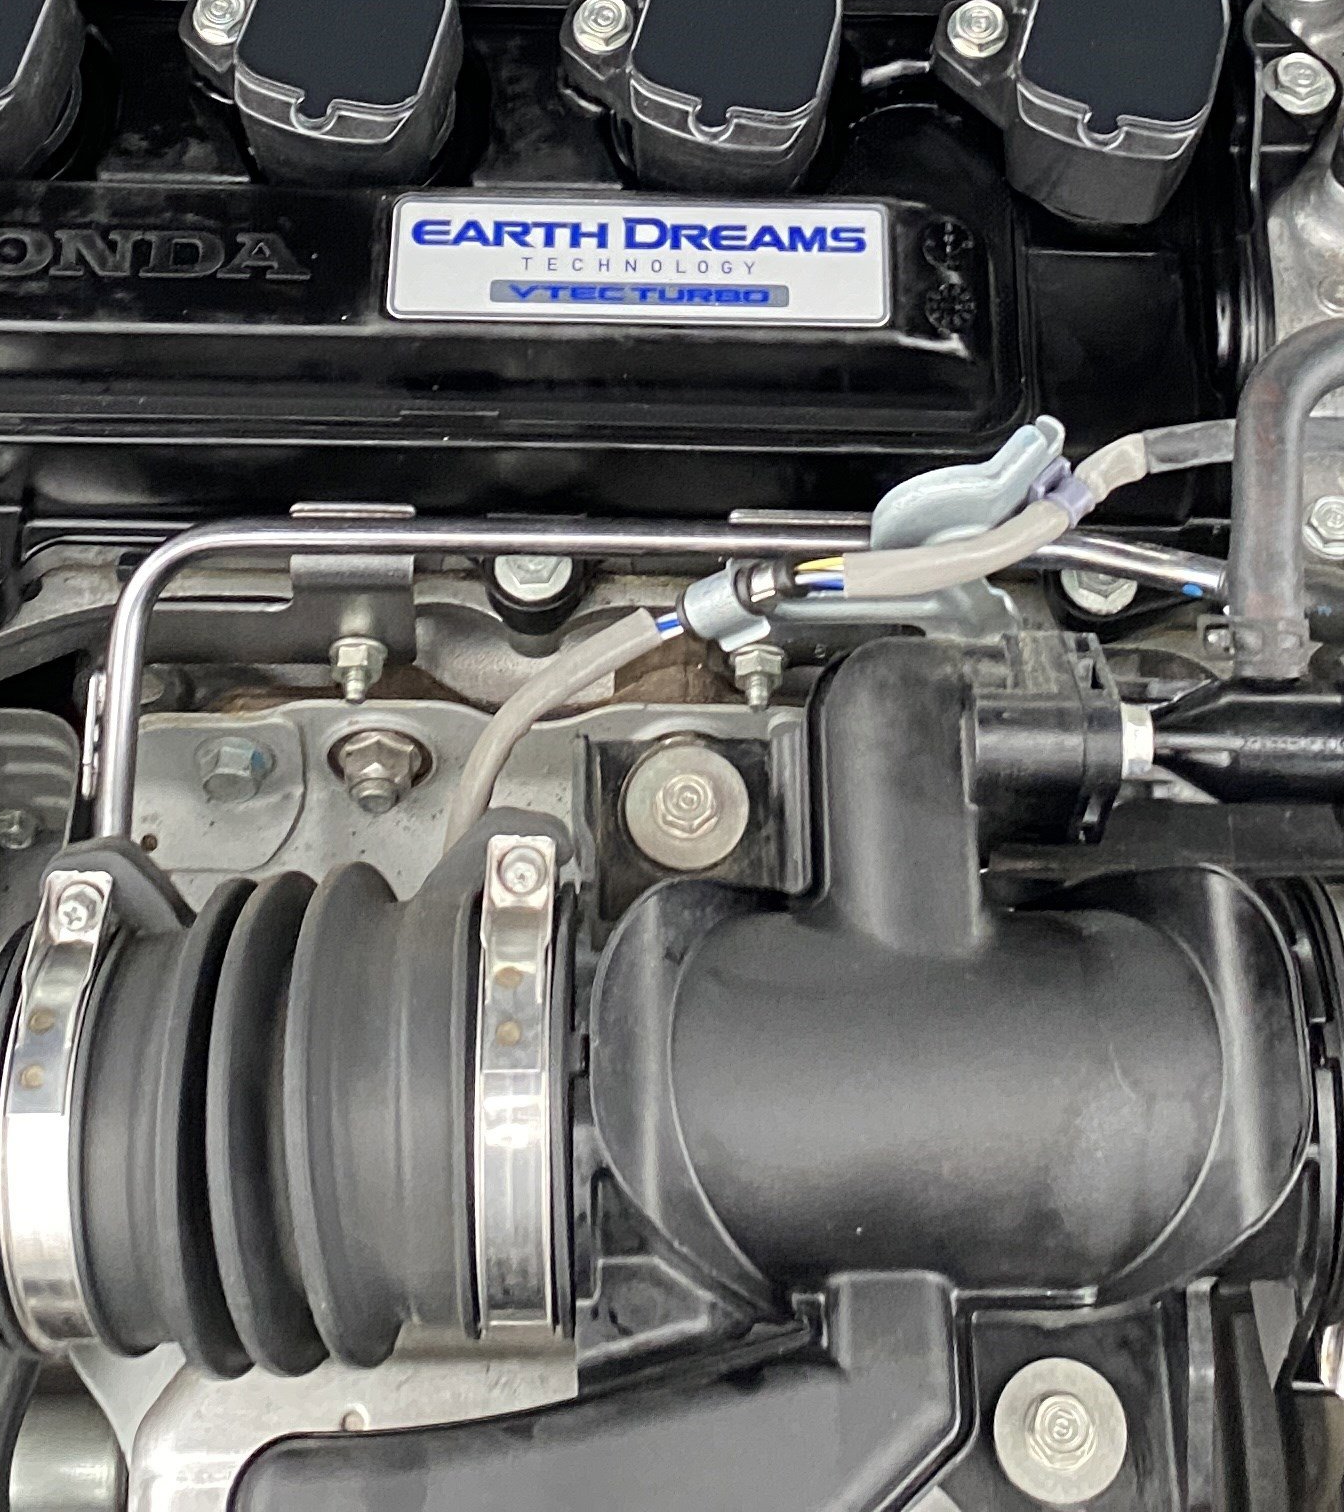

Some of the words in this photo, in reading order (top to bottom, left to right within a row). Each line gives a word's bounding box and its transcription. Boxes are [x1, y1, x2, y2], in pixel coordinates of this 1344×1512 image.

[410, 217, 610, 250] EARTH
[621, 217, 867, 254] DREAMS
[520, 256, 757, 276] TECHNOLOGY
[508, 282, 626, 303] VTEC
[632, 286, 771, 305] TURBO
